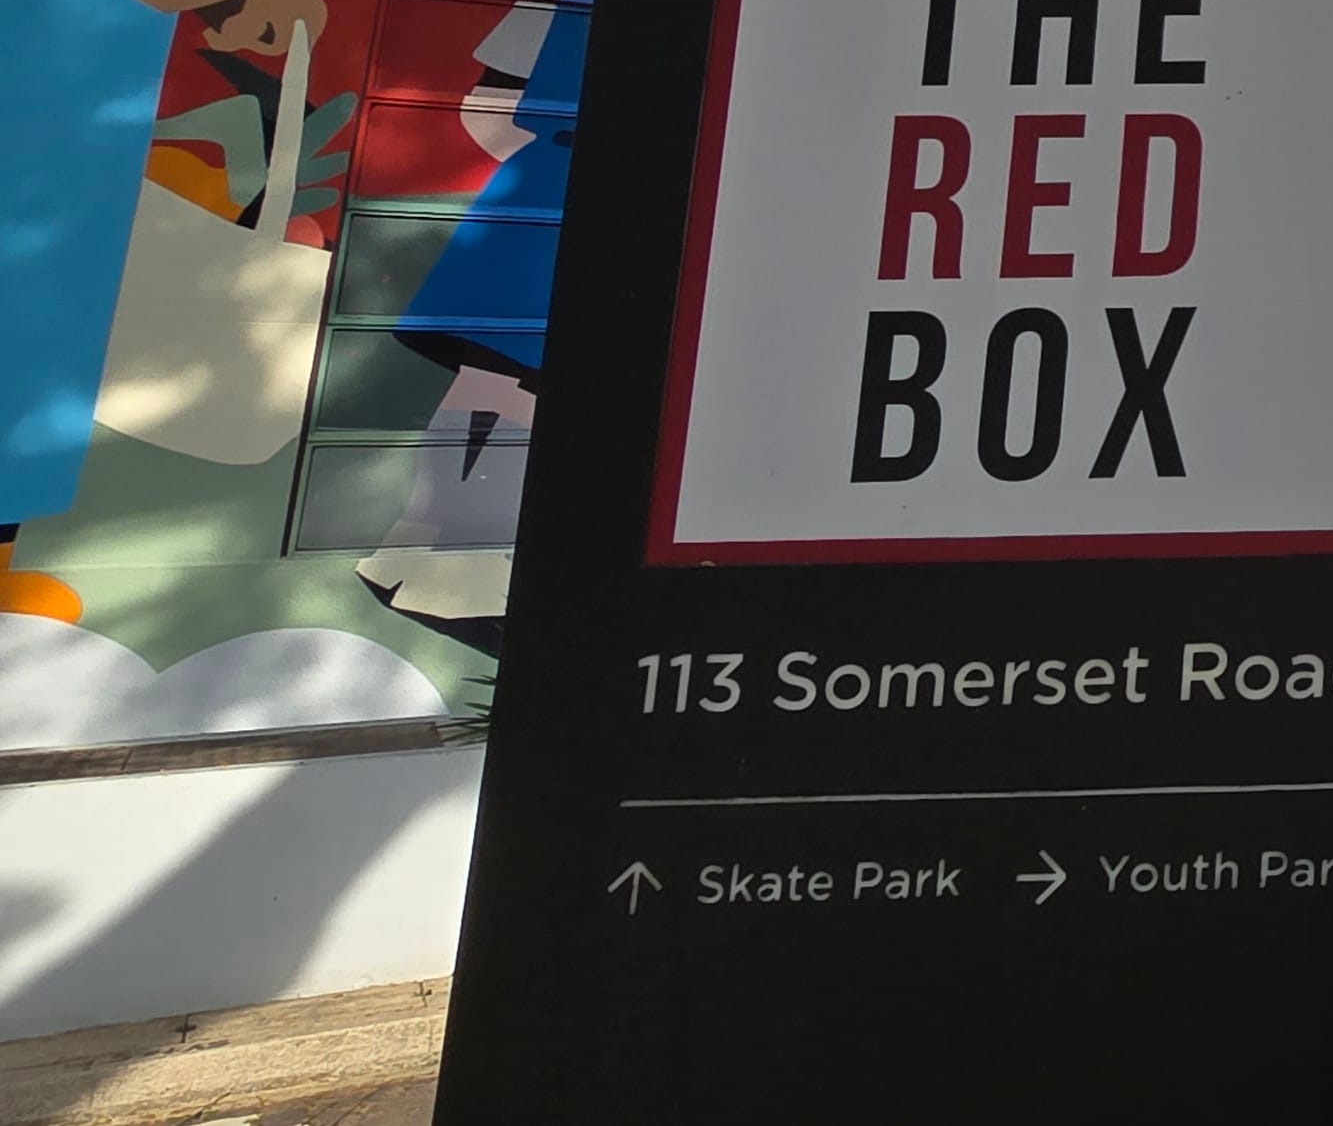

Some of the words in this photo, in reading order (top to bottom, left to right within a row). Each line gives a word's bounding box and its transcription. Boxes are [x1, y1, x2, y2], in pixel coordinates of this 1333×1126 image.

[878, 114, 1202, 280] RED
[851, 307, 1197, 483] BOX
[639, 654, 743, 713] 113
[774, 648, 1148, 710] Somerset
[698, 865, 832, 903] Skate
[854, 860, 960, 899] Park
[1100, 852, 1238, 892] Youth
